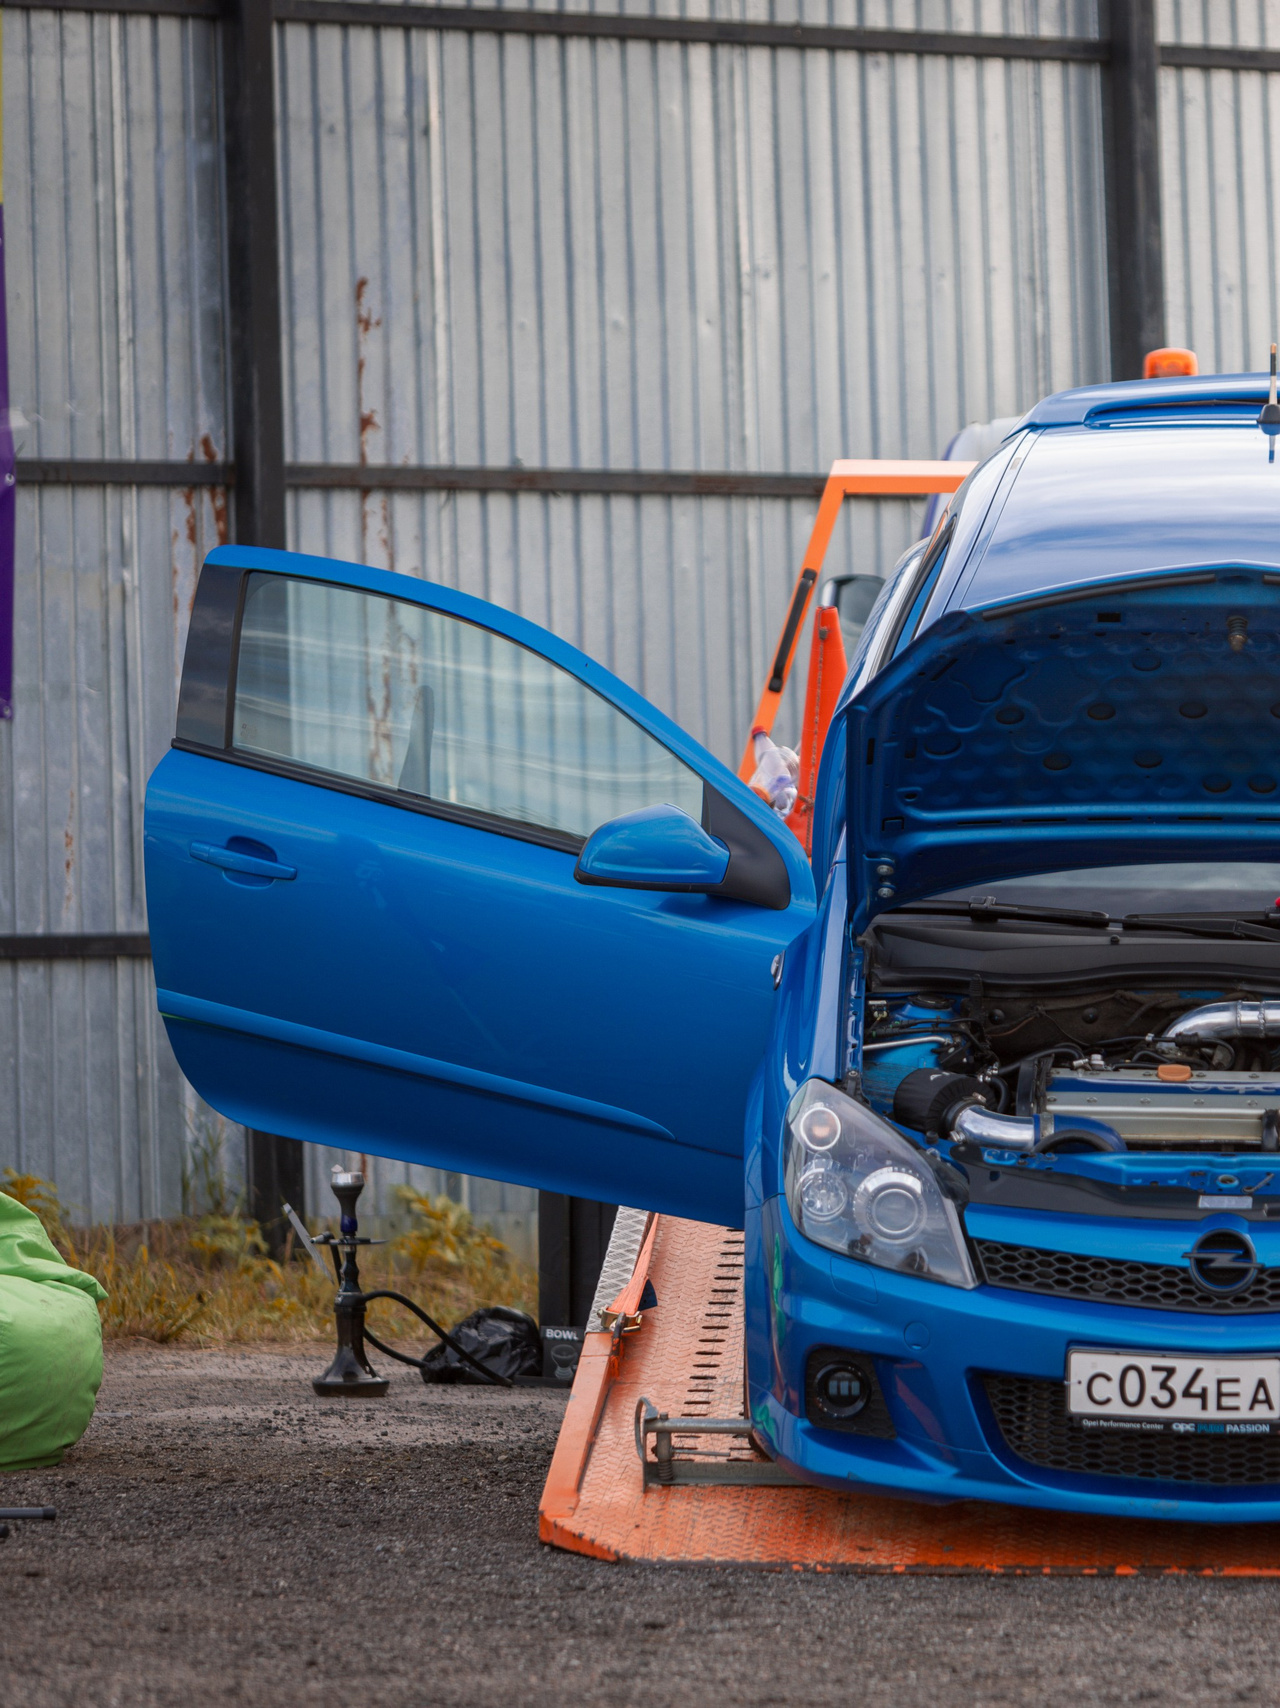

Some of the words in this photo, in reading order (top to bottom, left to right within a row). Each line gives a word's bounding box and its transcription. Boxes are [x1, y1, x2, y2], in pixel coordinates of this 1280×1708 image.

[1082, 1418, 1099, 1427] Opel
[1100, 1420, 1141, 1429] Performance
[1142, 1421, 1164, 1430] Center
[1226, 1423, 1270, 1433] PASSION
